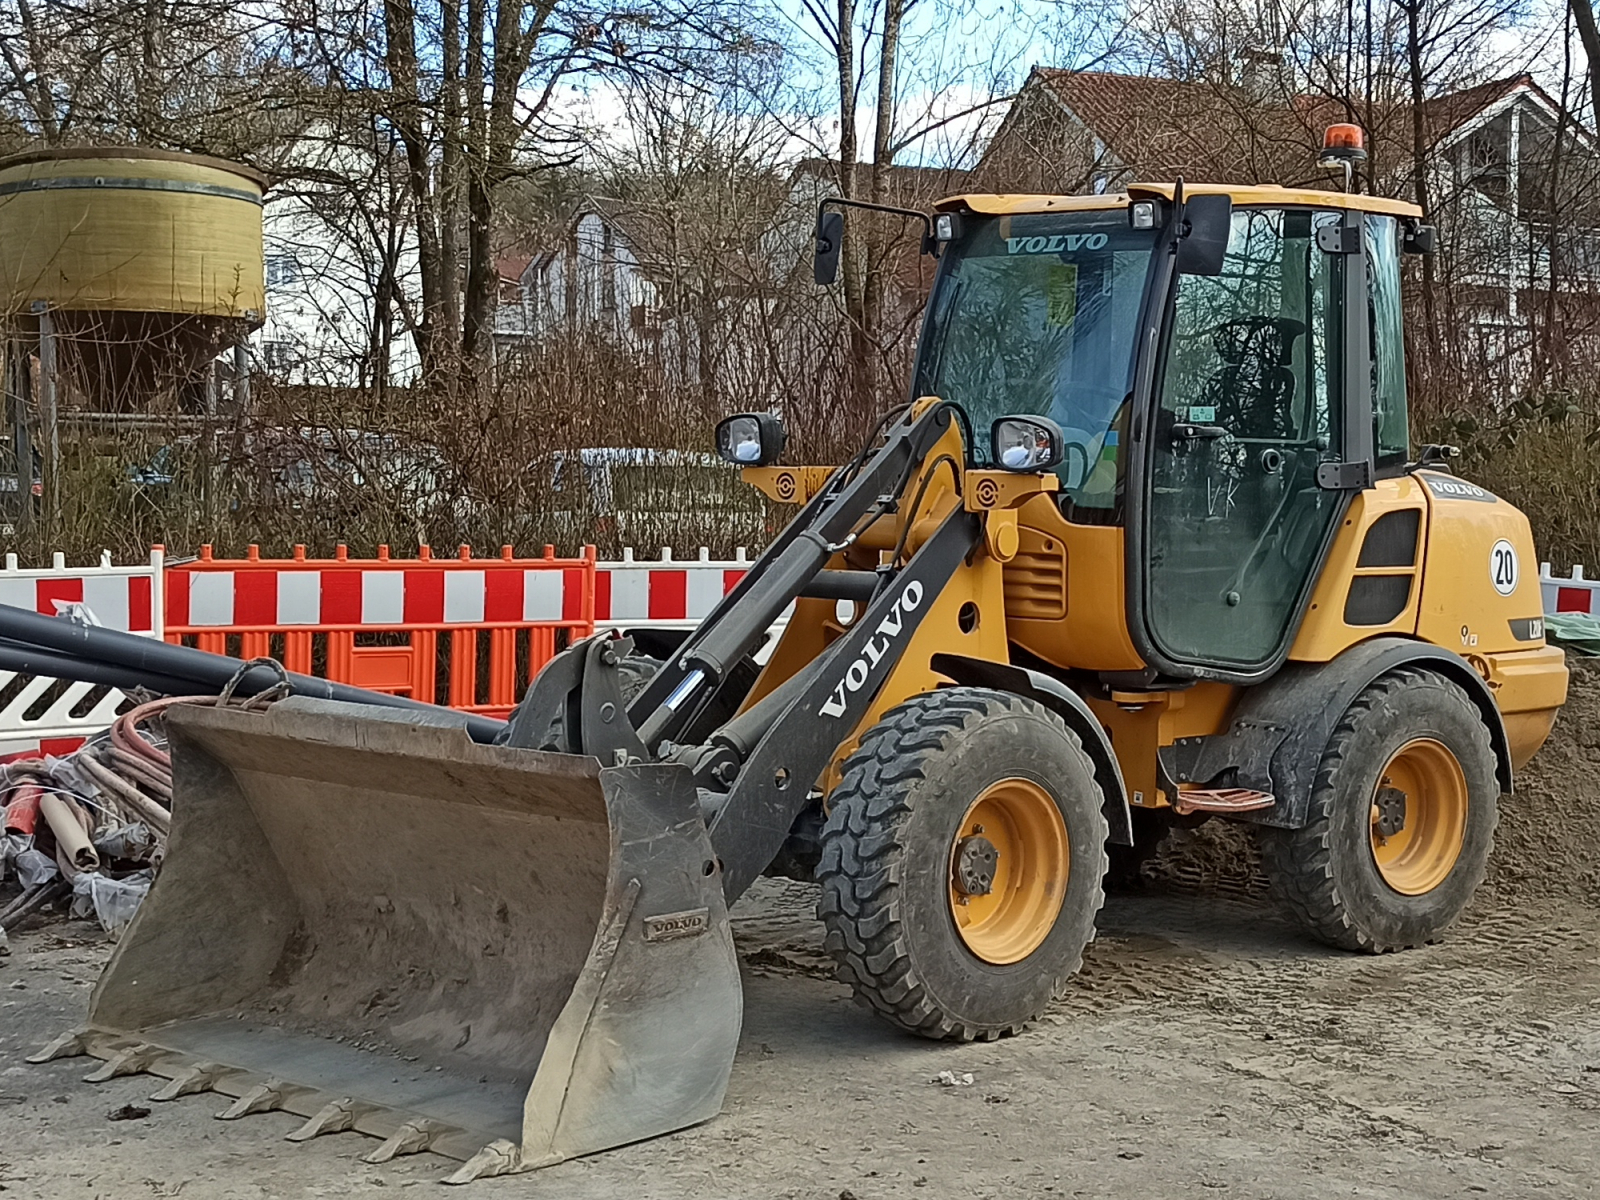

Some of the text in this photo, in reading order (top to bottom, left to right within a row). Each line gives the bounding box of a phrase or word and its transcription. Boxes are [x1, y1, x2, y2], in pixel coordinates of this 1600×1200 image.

[1005, 233, 1108, 254] VOLVO
[1428, 481, 1484, 497] VOLVO
[1495, 549, 1513, 585] 20
[818, 580, 924, 718] VOLVO
[653, 917, 702, 932] VOLVO
